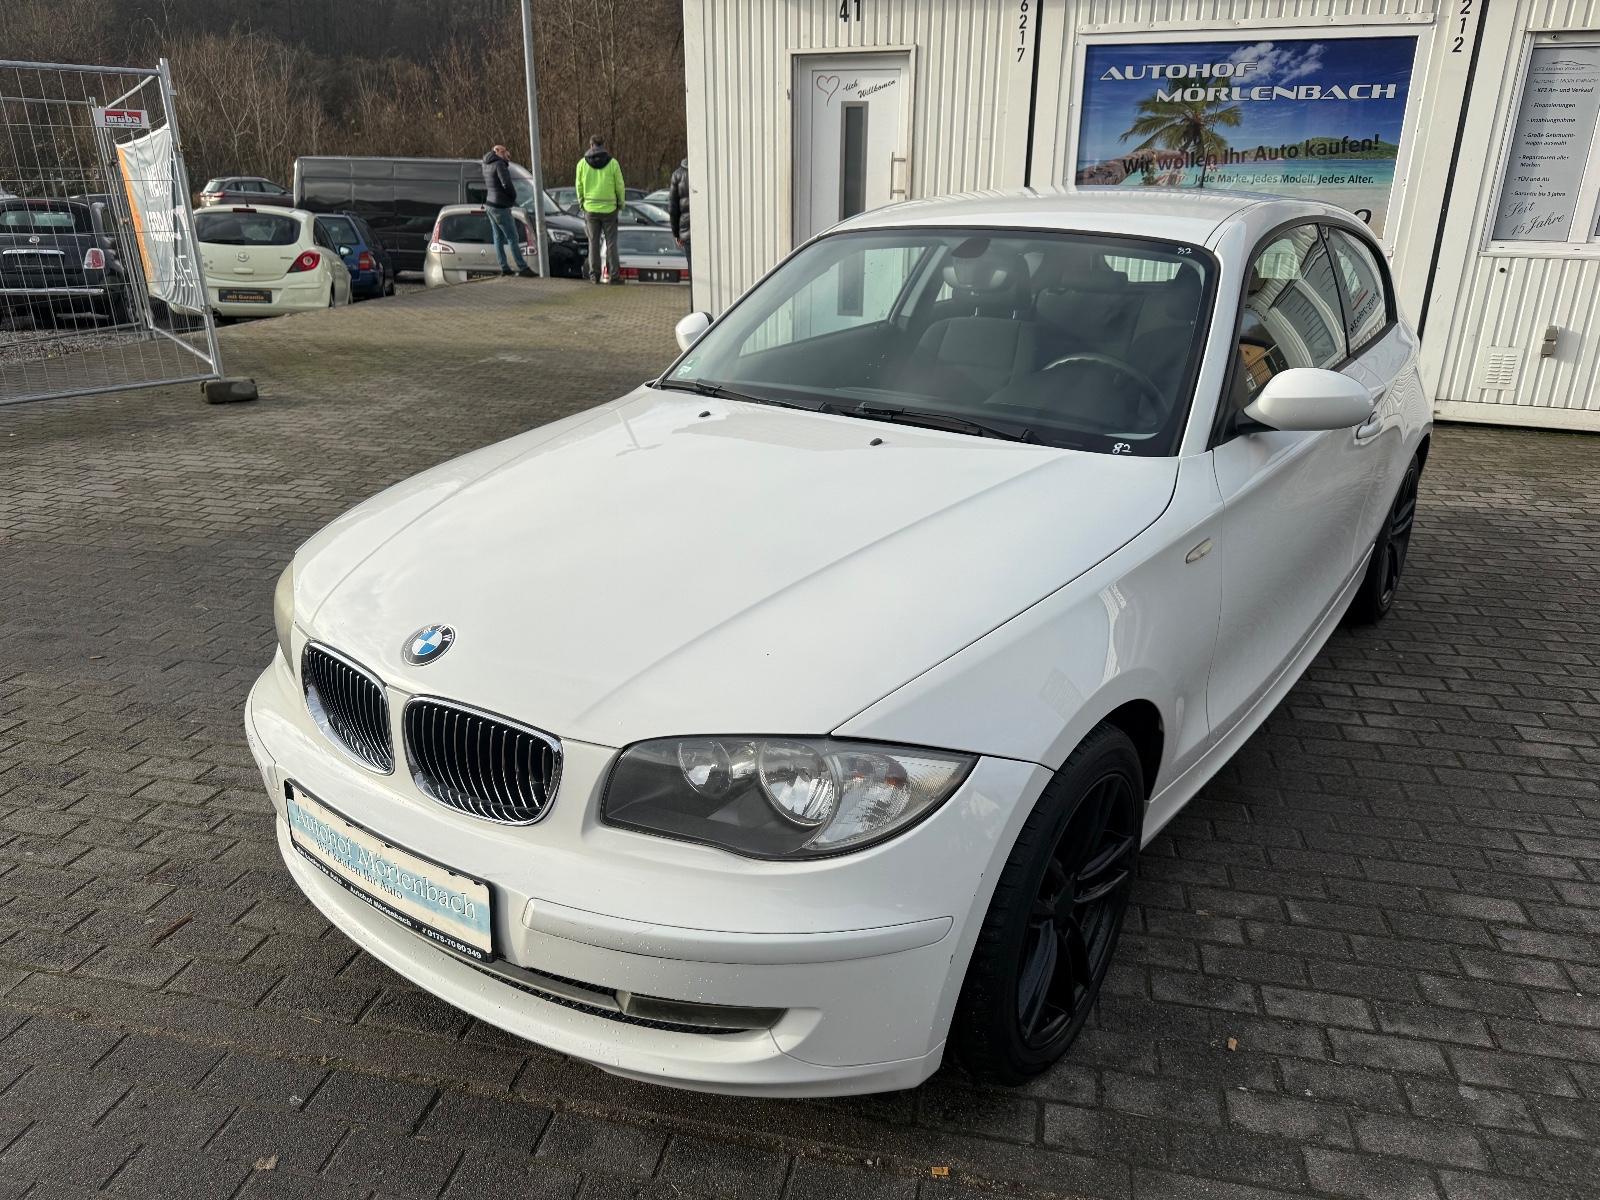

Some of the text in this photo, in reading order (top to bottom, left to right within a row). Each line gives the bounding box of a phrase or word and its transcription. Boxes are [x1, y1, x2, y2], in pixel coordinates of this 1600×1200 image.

[840, 0, 860, 22] 41
[1100, 62, 1257, 80] AUTOHOF
[1156, 83, 1397, 102] MÖRLENBACH
[1157, 148, 1218, 170] wollen
[1224, 147, 1248, 164] Ihr
[1253, 144, 1299, 162] Auto
[1305, 133, 1380, 157] kaufen!
[1317, 174, 1345, 185] Jedes
[1347, 174, 1374, 184] Alter.
[1505, 201, 1535, 218] Seit
[1525, 212, 1564, 234] Jahre
[1112, 442, 1132, 455] 82
[297, 806, 476, 920] Autohof Mörlenbach
